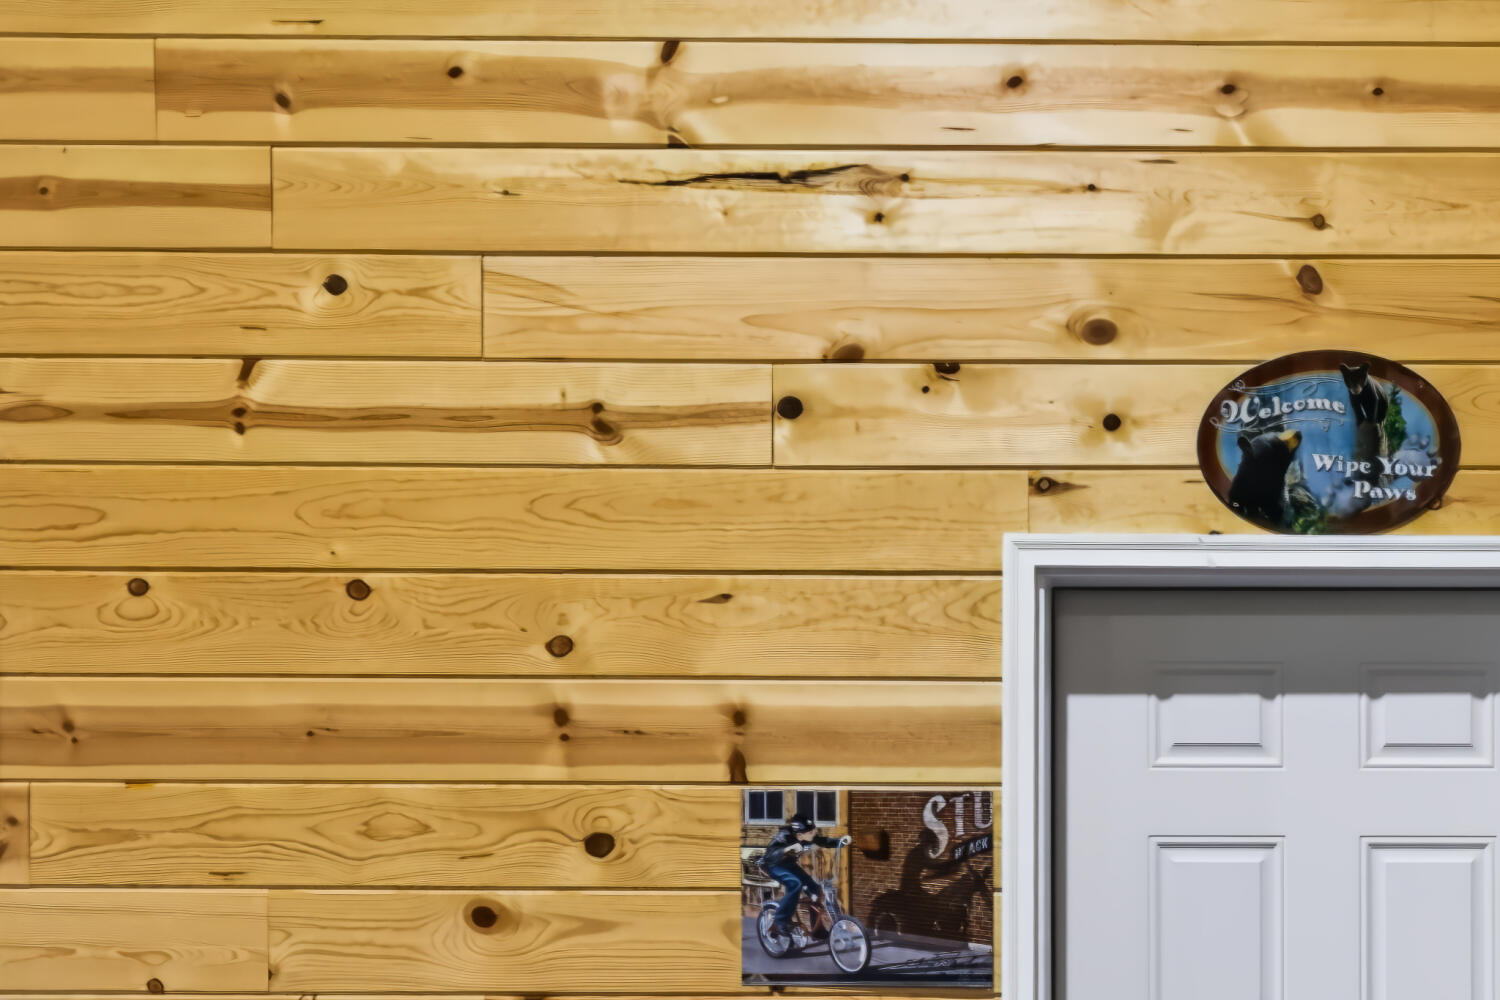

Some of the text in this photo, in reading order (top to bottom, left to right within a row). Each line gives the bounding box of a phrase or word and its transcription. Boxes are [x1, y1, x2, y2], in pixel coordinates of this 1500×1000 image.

[1220, 396, 1346, 424] Welcome
[1311, 453, 1437, 478] Wipe Your
[1353, 480, 1417, 501] Paws
